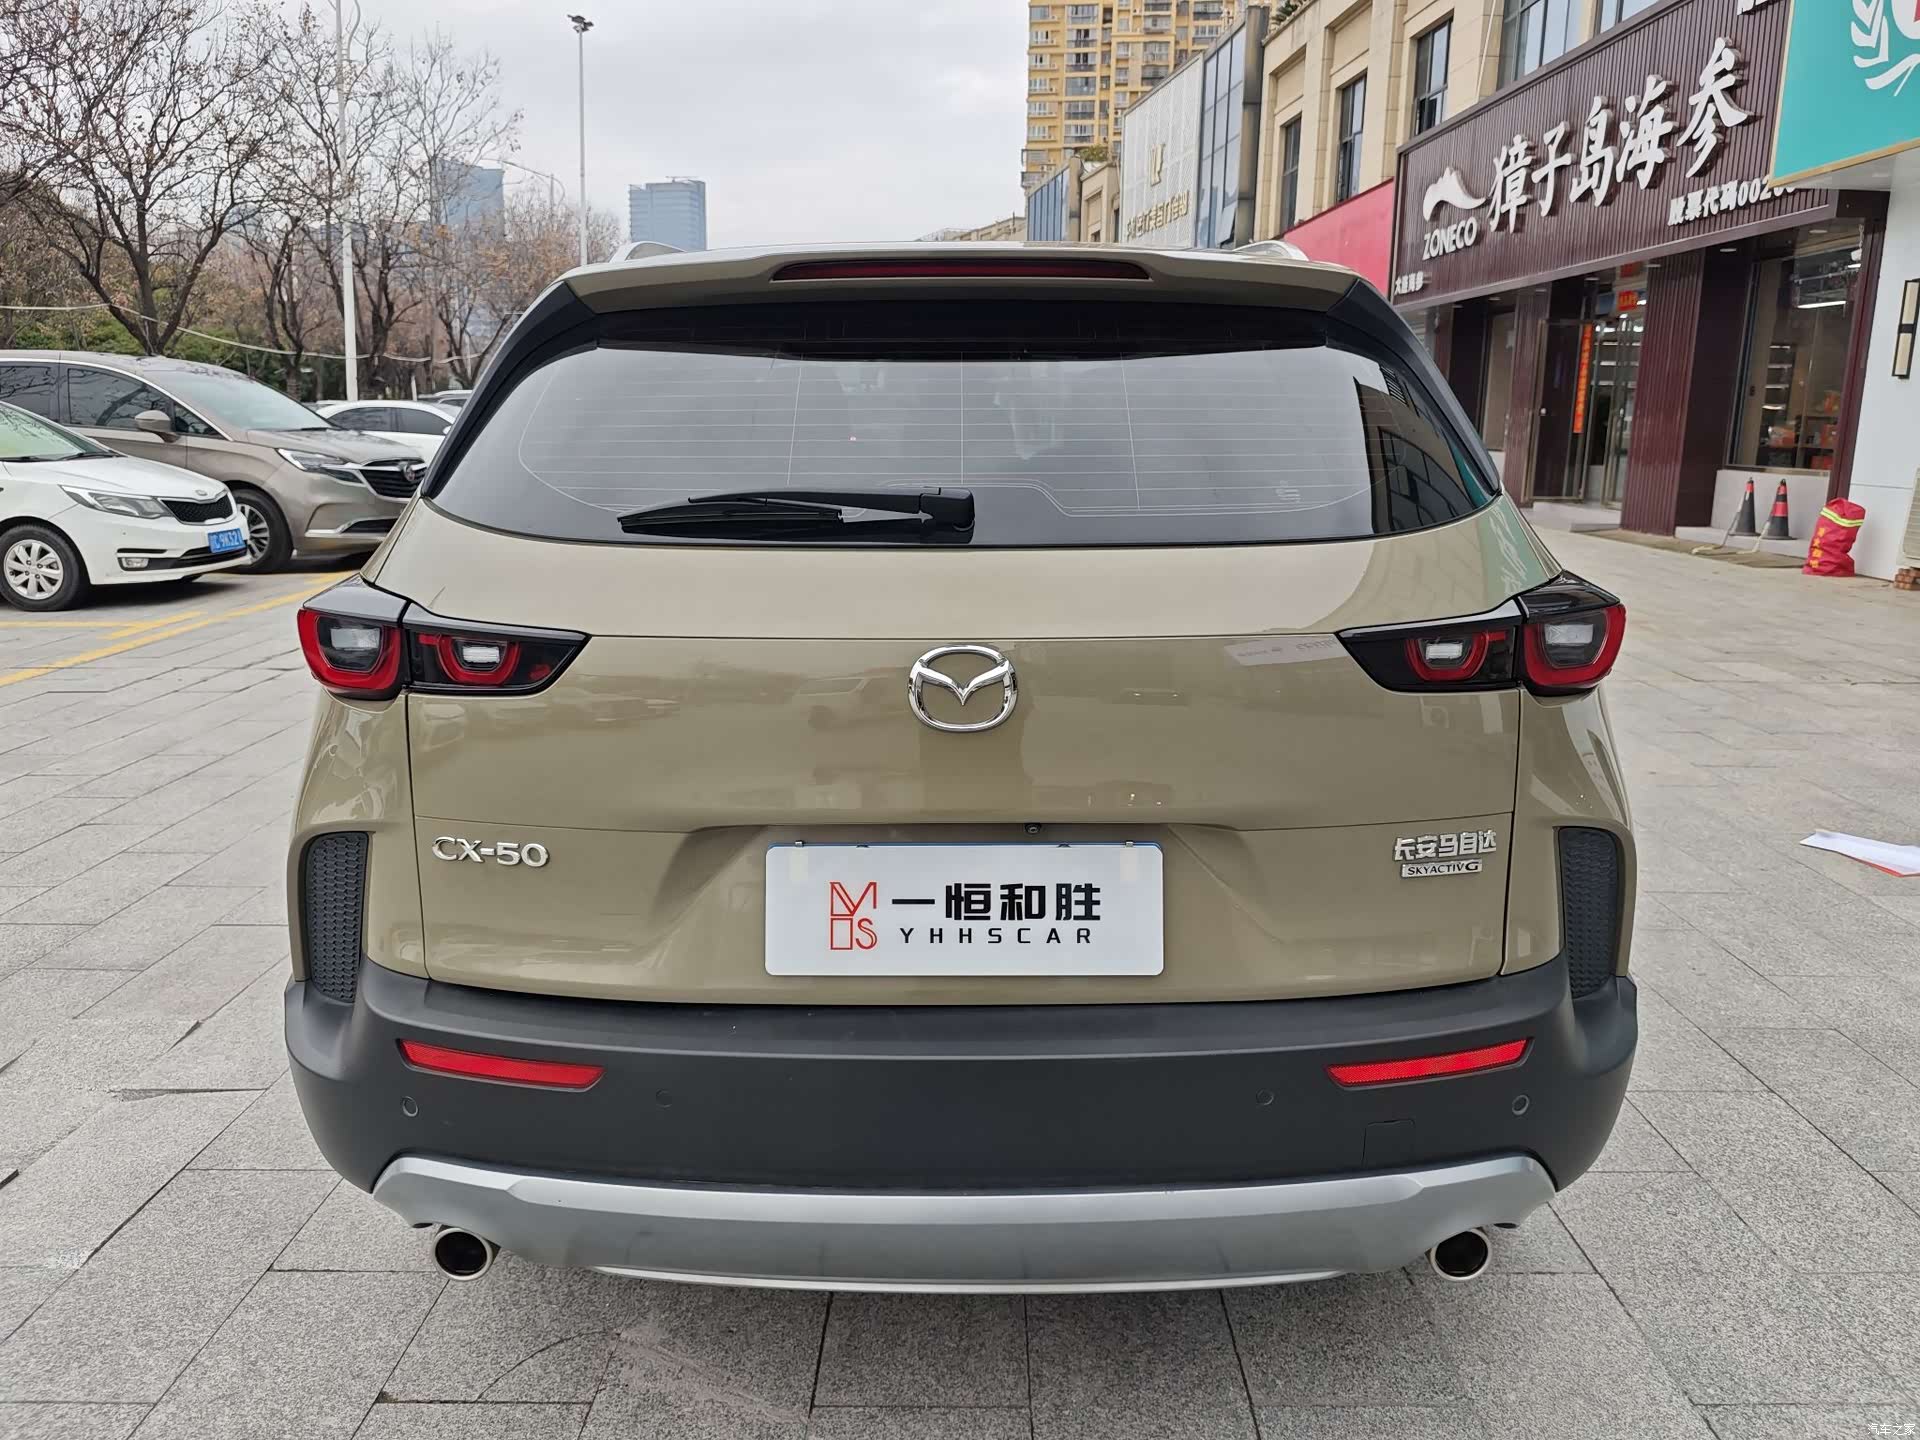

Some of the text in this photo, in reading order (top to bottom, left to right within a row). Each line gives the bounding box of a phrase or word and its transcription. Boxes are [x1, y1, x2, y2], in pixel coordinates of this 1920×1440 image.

[1488, 37, 1749, 233] 獐子岛海参
[1422, 217, 1477, 260] ZONECO
[432, 836, 548, 868] CX-50
[1394, 830, 1497, 861] 长安马自达
[892, 883, 1101, 920] 一恒和胜
[900, 928, 1090, 943] YHHSCAR
